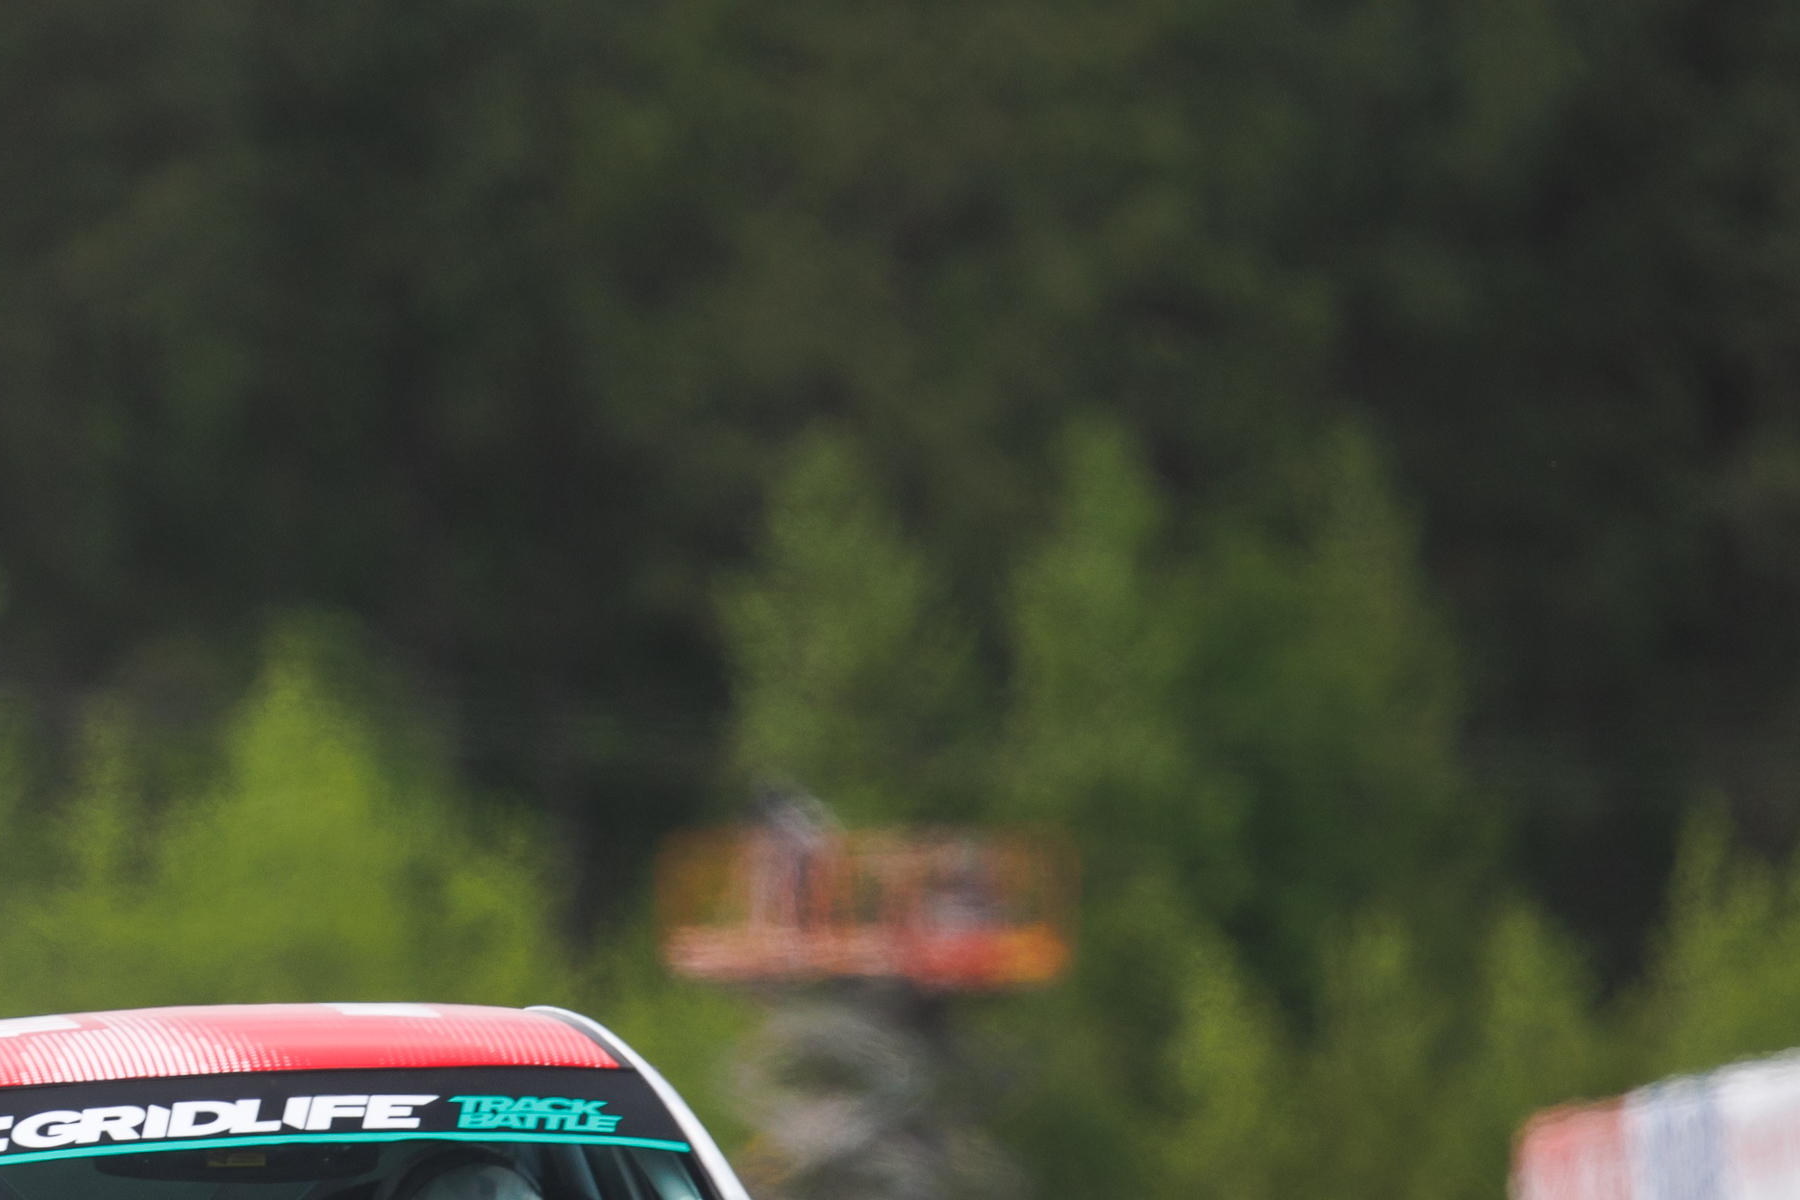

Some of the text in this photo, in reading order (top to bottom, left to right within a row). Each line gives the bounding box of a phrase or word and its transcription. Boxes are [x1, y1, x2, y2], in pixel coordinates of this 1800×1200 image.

[448, 1095, 608, 1115] TRACK
[11, 1095, 440, 1148] GRIDLIFE
[457, 1112, 623, 1133] BATTLE
